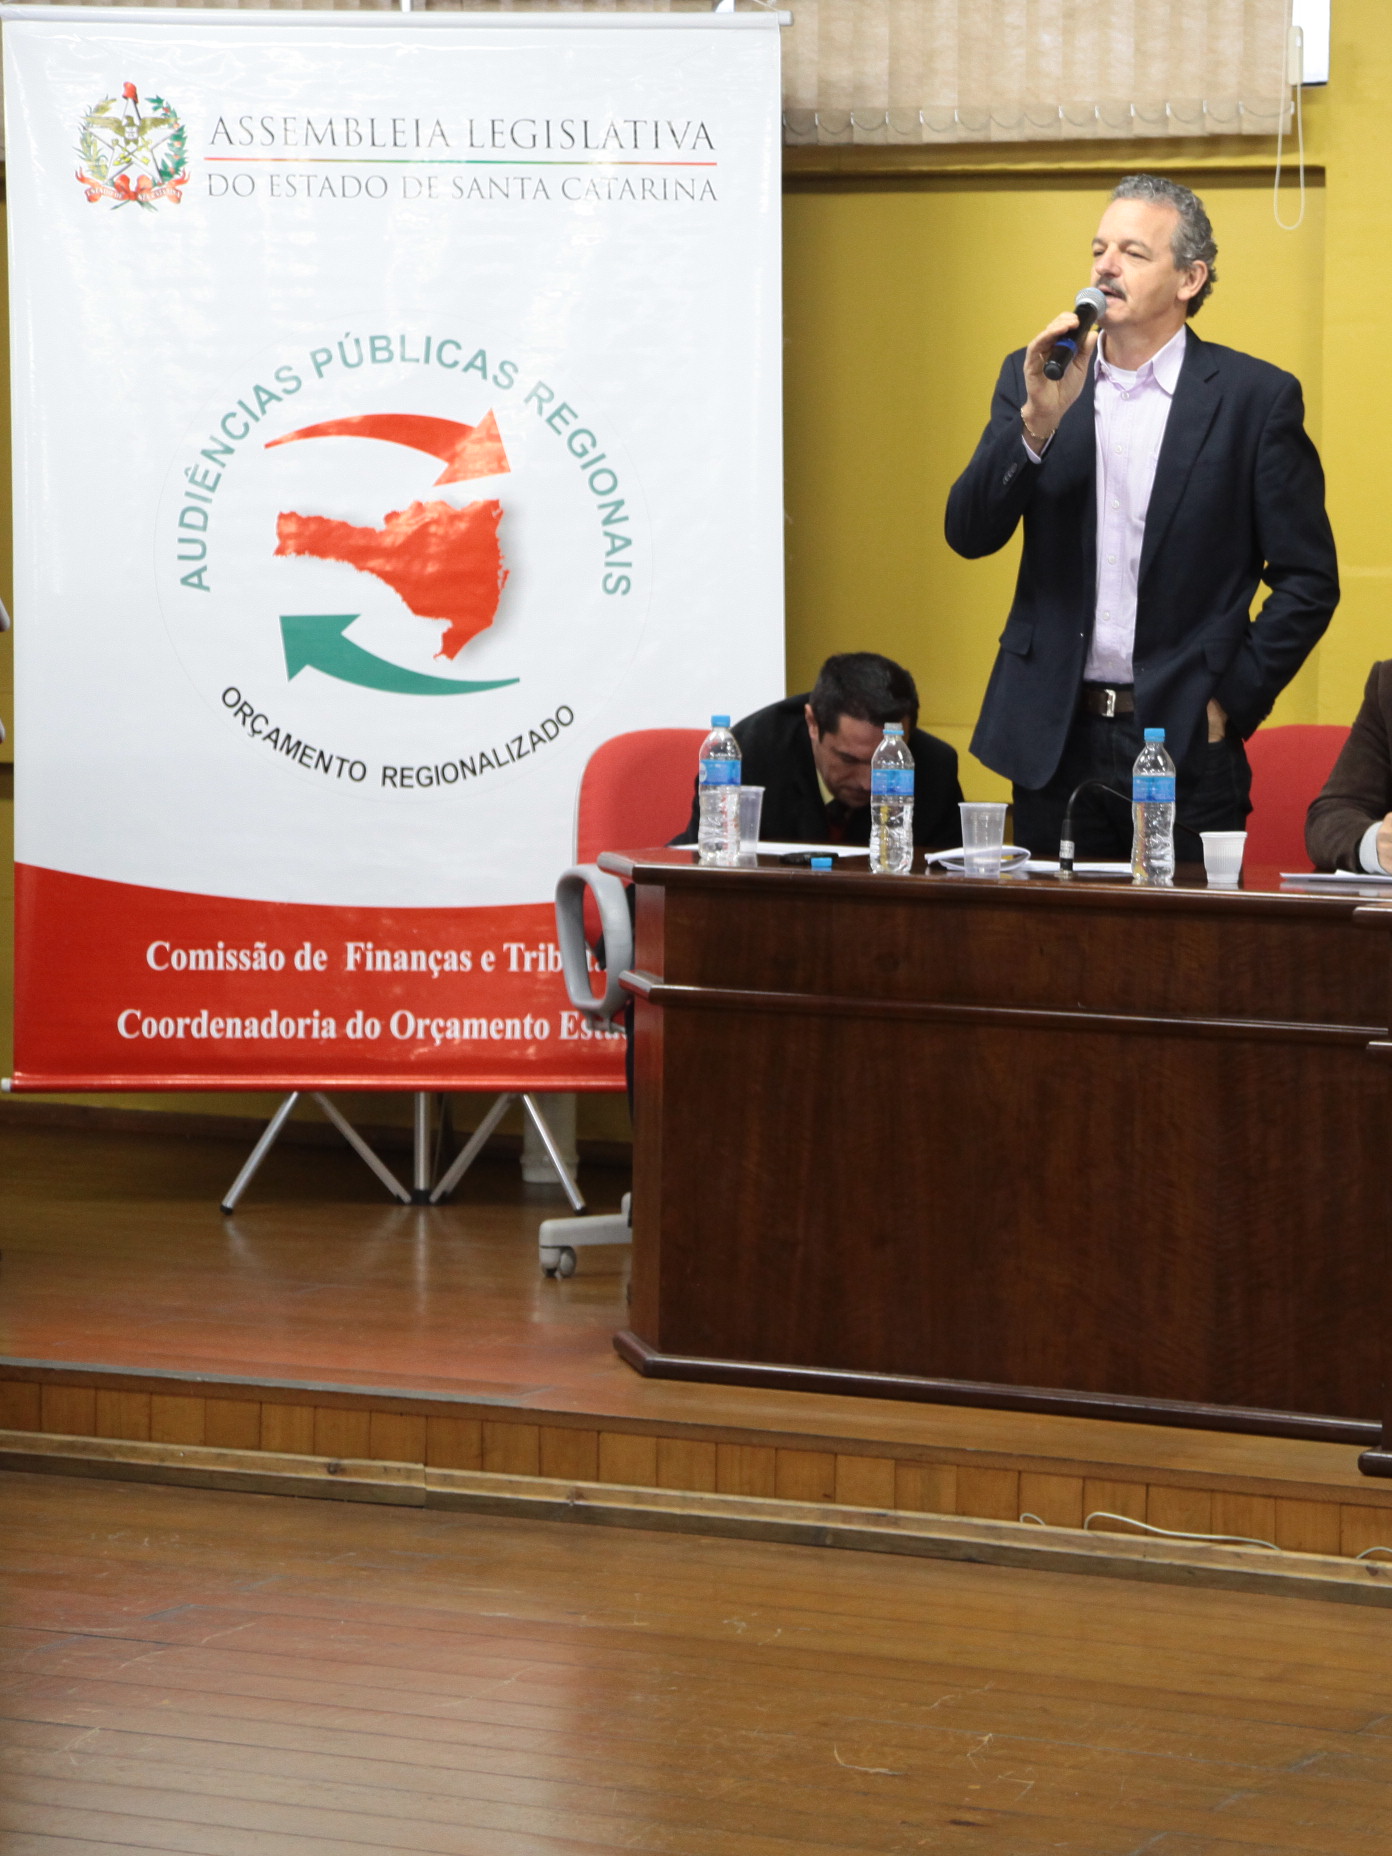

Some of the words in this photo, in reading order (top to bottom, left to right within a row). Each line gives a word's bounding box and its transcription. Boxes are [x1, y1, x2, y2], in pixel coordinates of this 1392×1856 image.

[210, 115, 451, 148] ASSEMBLEIA
[467, 118, 717, 151] LEGISLATIVA
[207, 173, 255, 198] DO
[269, 173, 388, 199] ESTADO
[402, 175, 439, 199] DE
[451, 175, 551, 200] SANTA
[561, 176, 719, 201] CATARINA
[176, 364, 303, 594] AUDIÊNCIAS
[309, 332, 520, 391] PÚBLICAS
[523, 381, 633, 597] REGIONAIS
[220, 685, 368, 784] ORÇAMENTO
[381, 704, 576, 789] REGIONALIZADO
[146, 940, 286, 972] Comissão
[293, 941, 328, 972] de
[345, 941, 473, 979] Finanças
[480, 949, 496, 972] e
[116, 1008, 337, 1039] Coordenadoria
[345, 1009, 381, 1040] do
[389, 1009, 550, 1046] Orçamento
